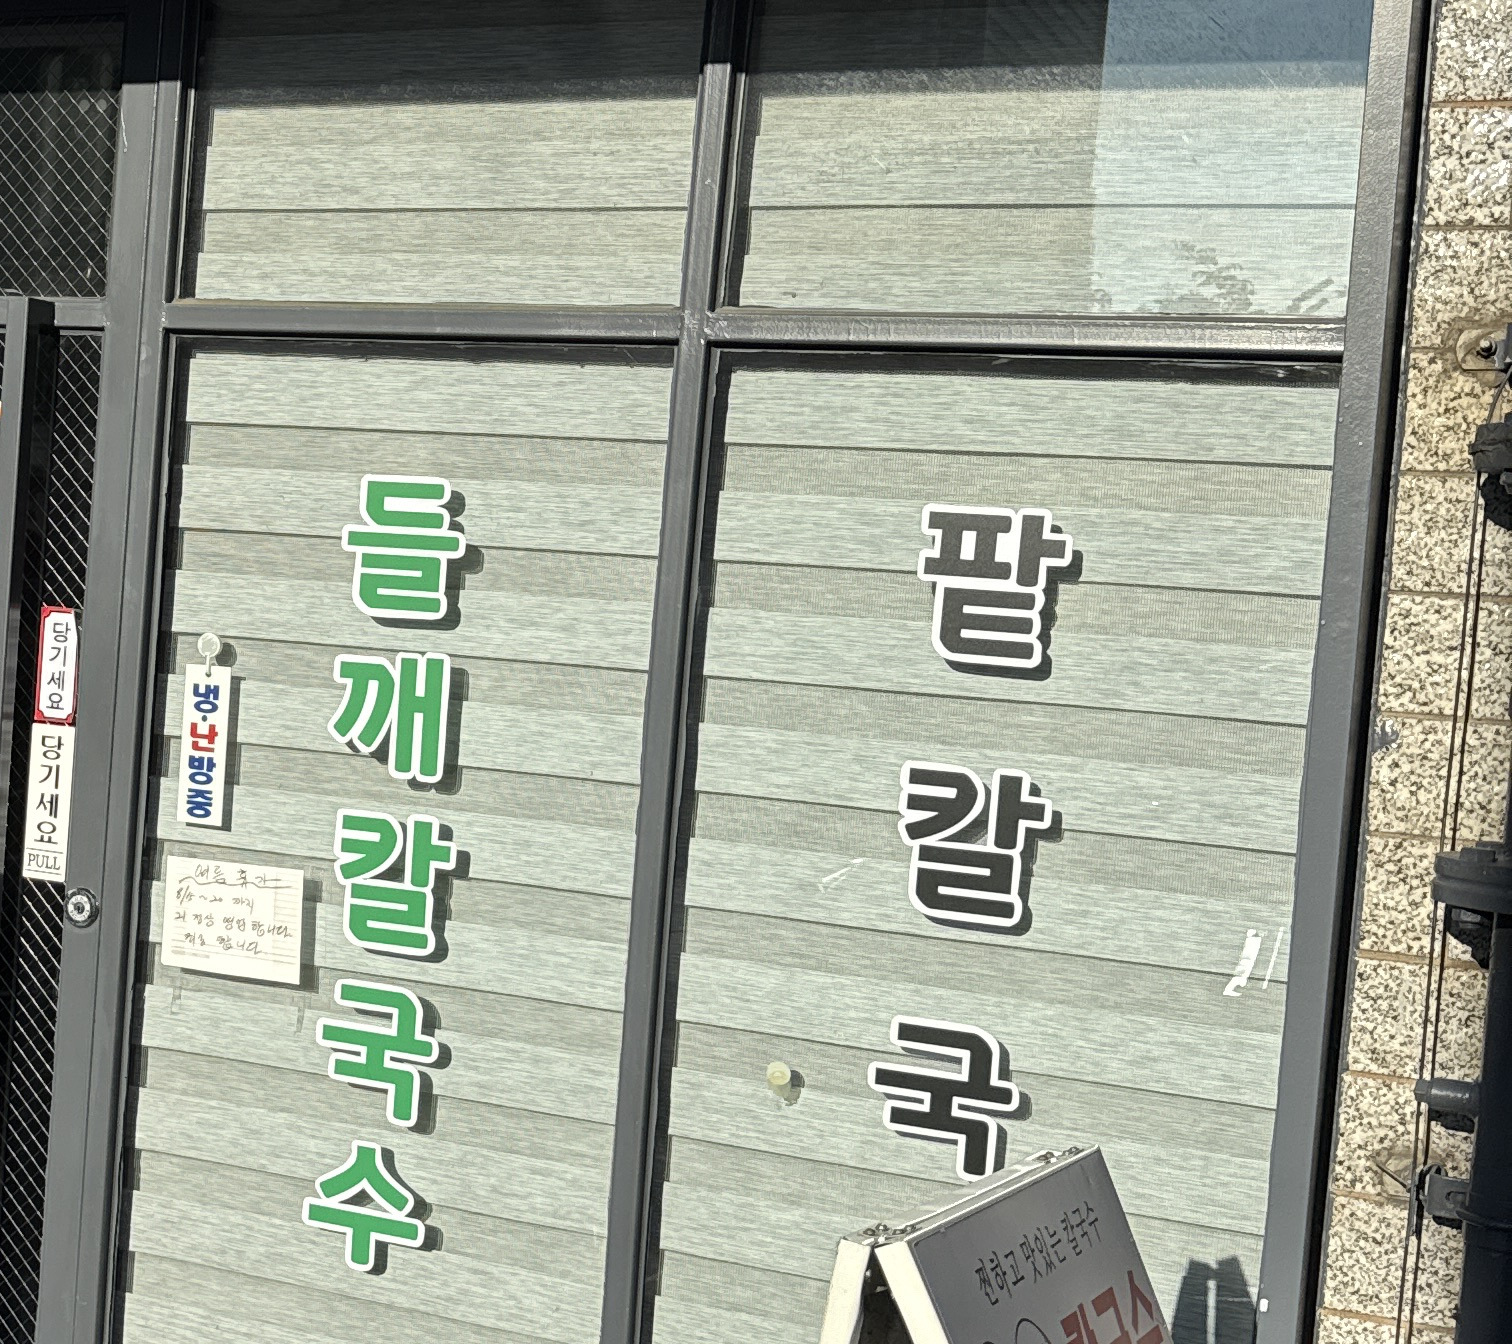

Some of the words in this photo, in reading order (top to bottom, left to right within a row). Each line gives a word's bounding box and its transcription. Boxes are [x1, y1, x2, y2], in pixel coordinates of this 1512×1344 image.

[46, 621, 72, 711] 당기세요
[34, 734, 65, 845] 당기세요
[27, 853, 61, 870] PULL
[303, 474, 466, 1271] 들깨칼국수
[975, 1256, 1025, 1306] 찐하고
[1023, 1225, 1066, 1283] 맛있는
[1061, 1201, 1102, 1257] 칼국수
